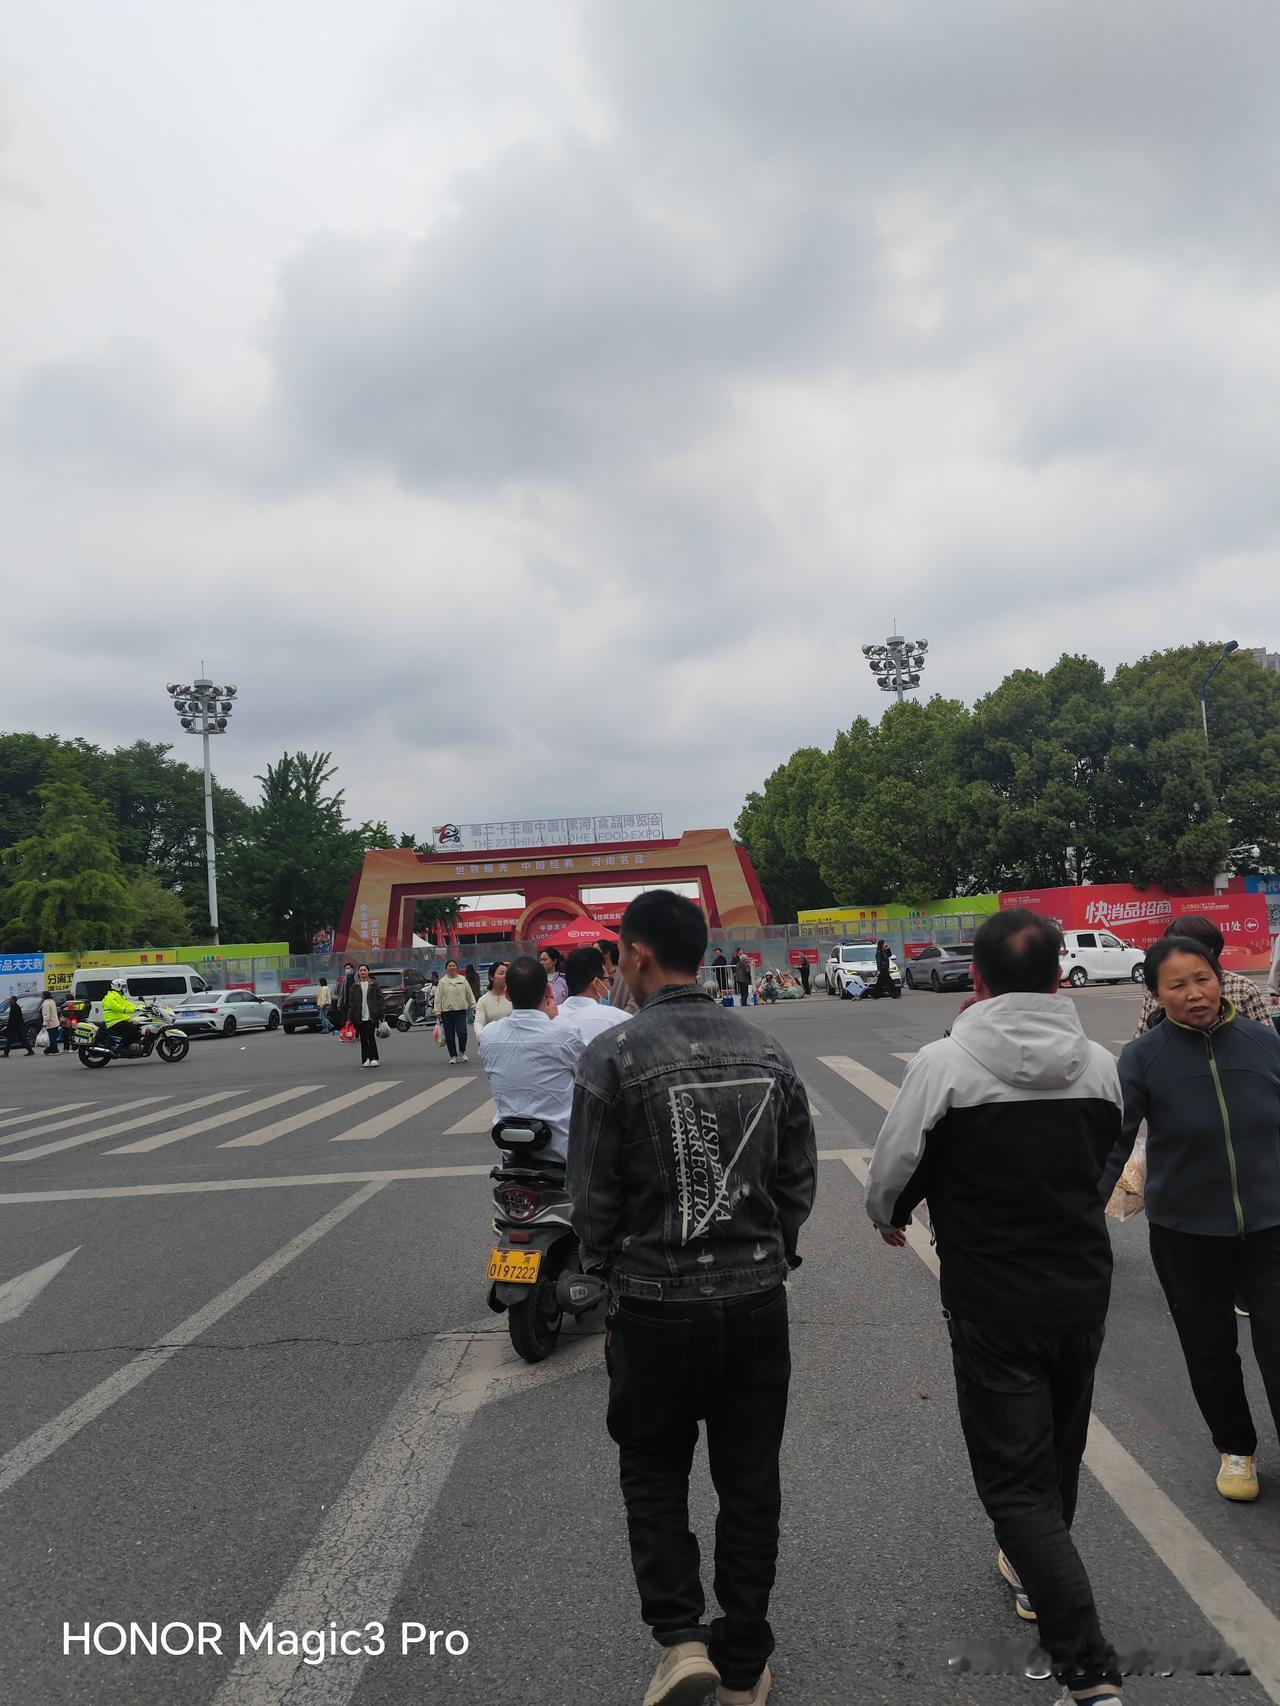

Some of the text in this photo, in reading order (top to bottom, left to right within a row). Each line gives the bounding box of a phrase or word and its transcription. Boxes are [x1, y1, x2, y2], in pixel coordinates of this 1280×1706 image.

[472, 840, 493, 849] THE
[496, 838, 507, 847] 23
[599, 831, 628, 840] FOOD
[631, 829, 660, 839] EXPO
[592, 855, 644, 866] 河南名品
[1086, 900, 1171, 927] 快消品招商
[681, 1092, 709, 1239] CORRECTION
[676, 1166, 692, 1221] SHOP
[490, 1264, 536, 1280] 0197222
